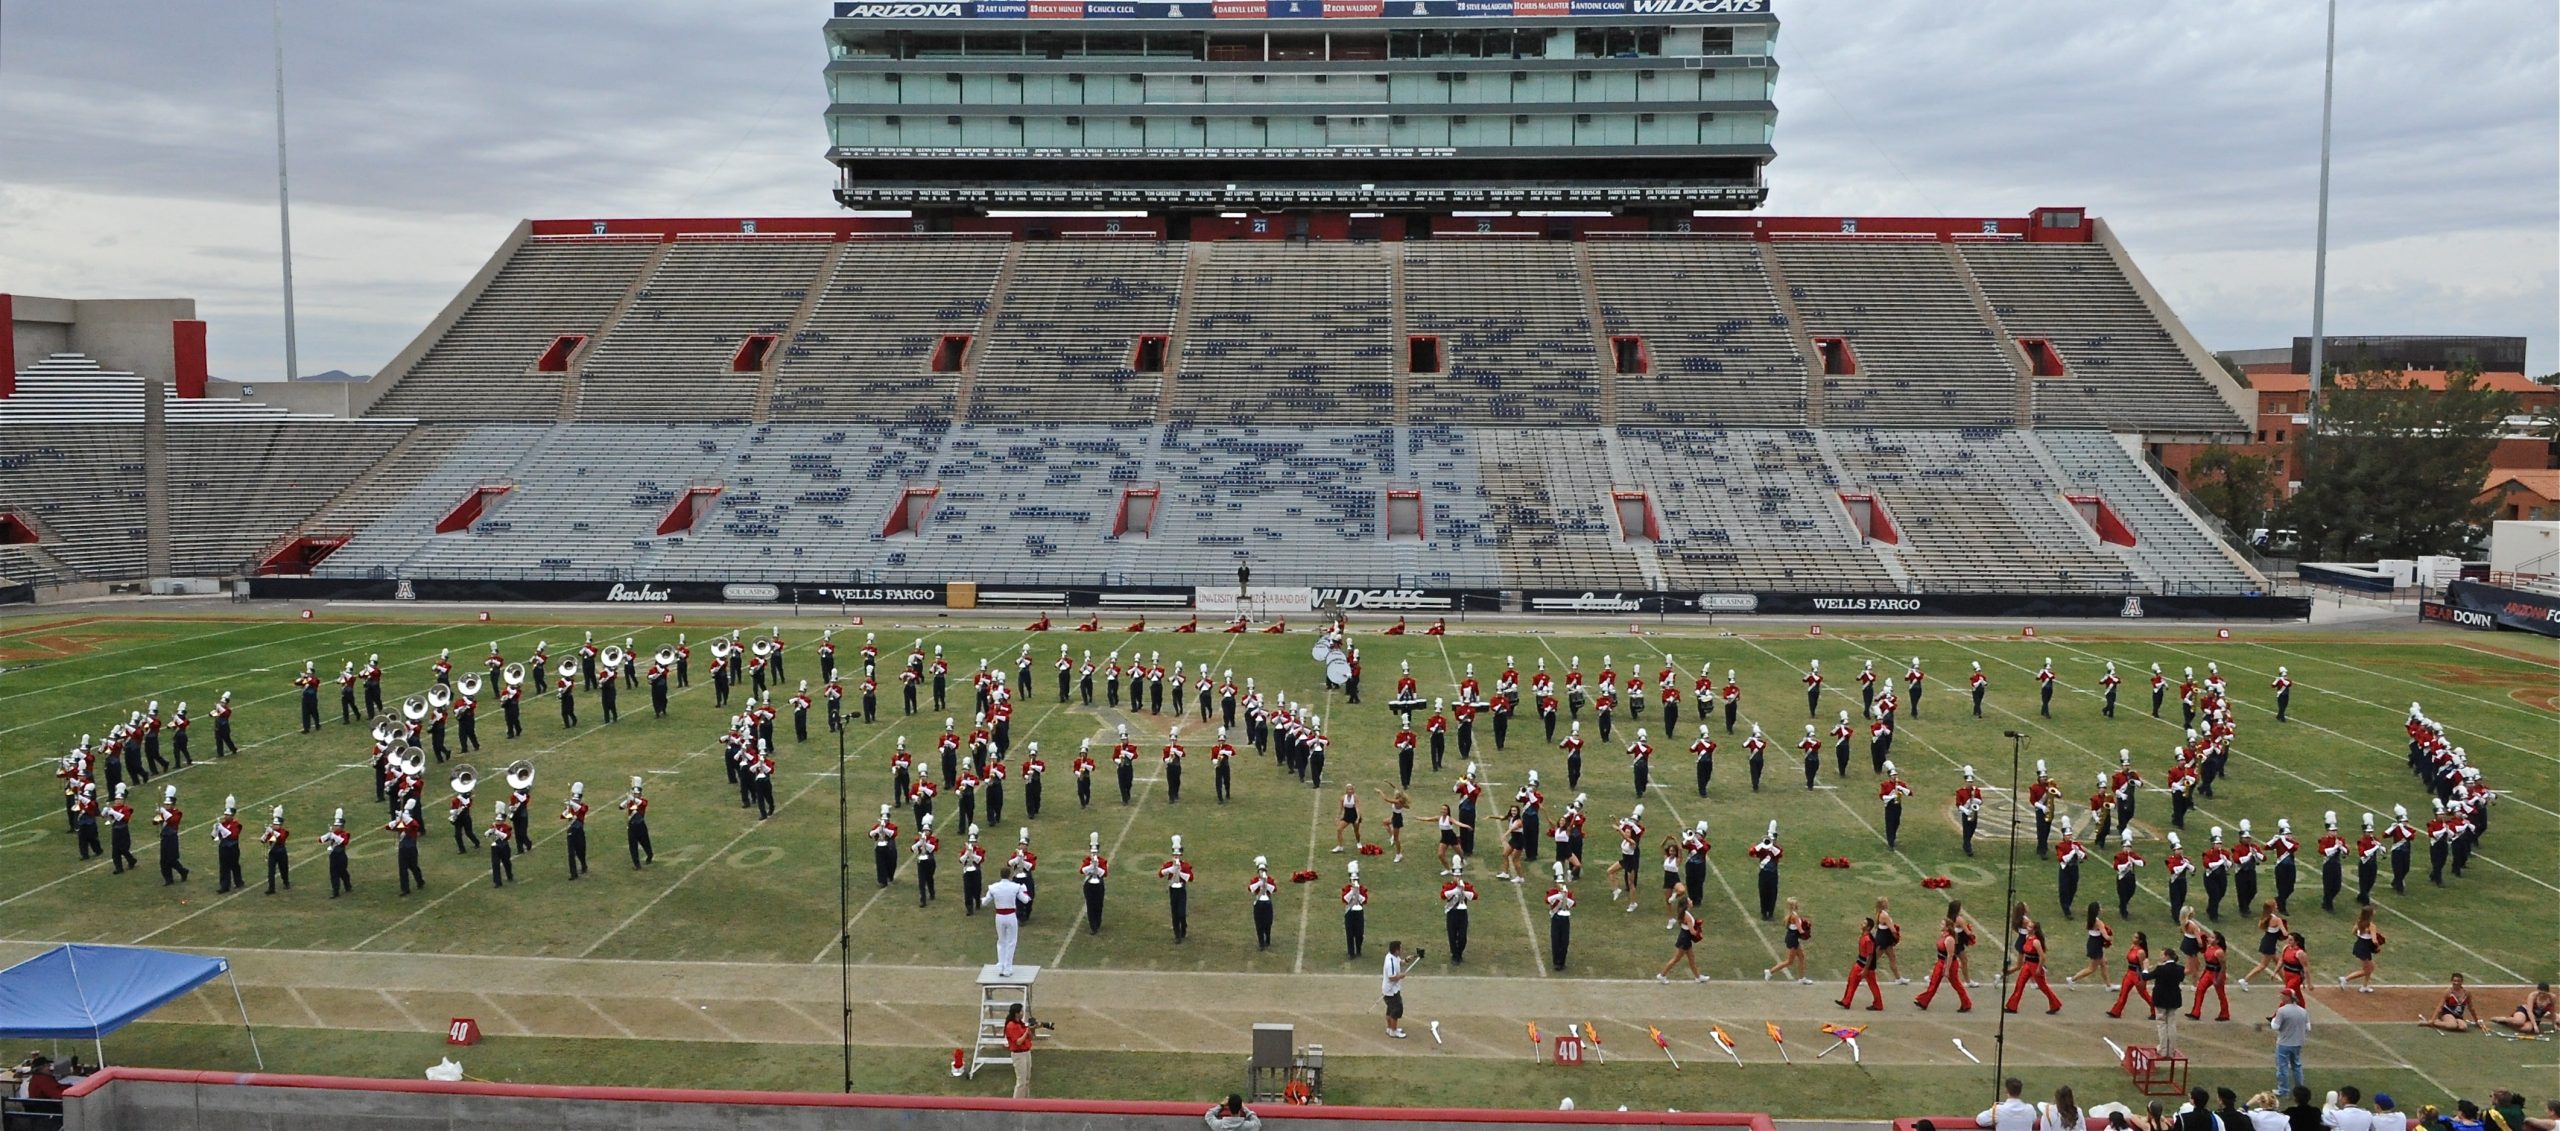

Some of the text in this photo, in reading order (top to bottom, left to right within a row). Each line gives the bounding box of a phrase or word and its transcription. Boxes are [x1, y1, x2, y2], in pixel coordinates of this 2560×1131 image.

[846, 4, 962, 17] ARIZONA
[1633, 0, 1763, 12] WILDCATS
[743, 224, 755, 234] 18
[913, 224, 924, 233] 19
[1106, 223, 1119, 232] 20
[1254, 223, 1266, 232] 21
[1478, 223, 1491, 232] 22
[1678, 223, 1690, 232] 23
[1842, 224, 1856, 233] 24
[1983, 224, 1997, 233] 25
[243, 387, 253, 395] 16
[607, 583, 671, 601] Bashas'
[831, 589, 935, 600] WELLS FARGO
[1813, 599, 1921, 611] WELLS FARGO
[450, 1022, 469, 1041] 40
[1558, 1041, 1578, 1061] 40
